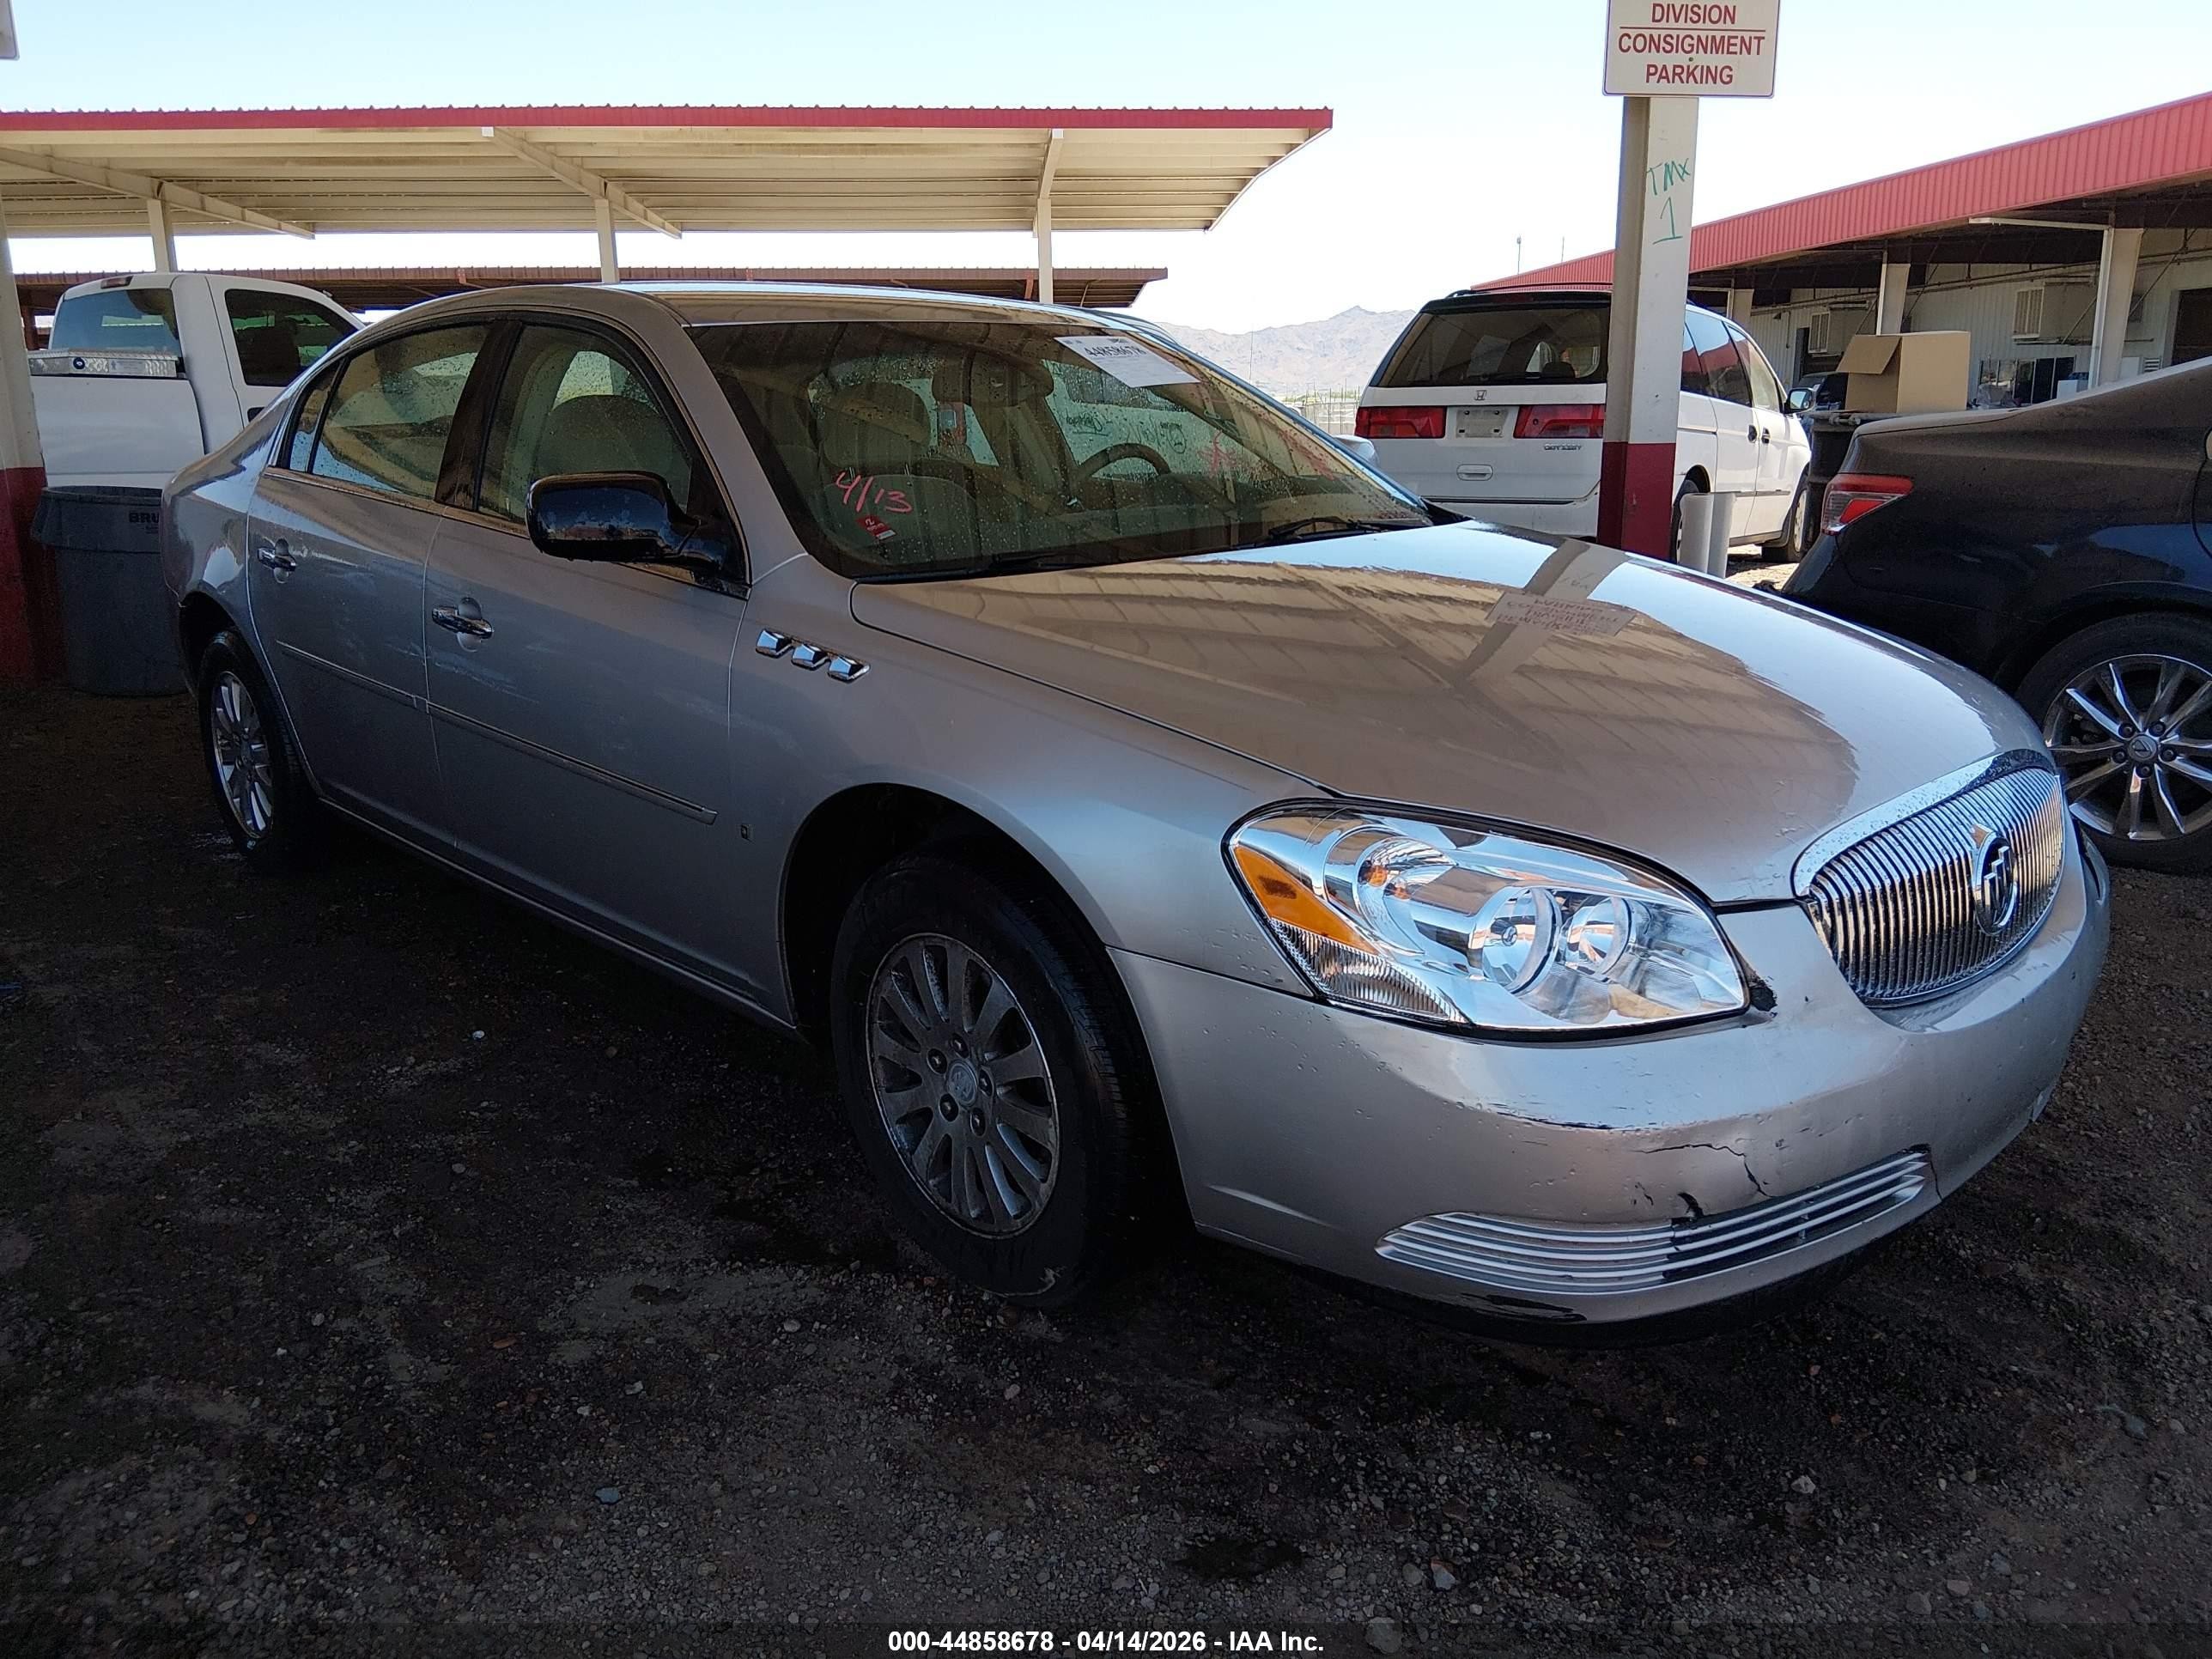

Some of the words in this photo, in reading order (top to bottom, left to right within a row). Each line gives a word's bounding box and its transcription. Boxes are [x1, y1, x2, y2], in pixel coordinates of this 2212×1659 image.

[1651, 3, 1736, 24] DIVISION
[1618, 33, 1765, 55] CONSIGNMENT
[1645, 64, 1734, 84] PARKING
[836, 471, 913, 513] 4/13
